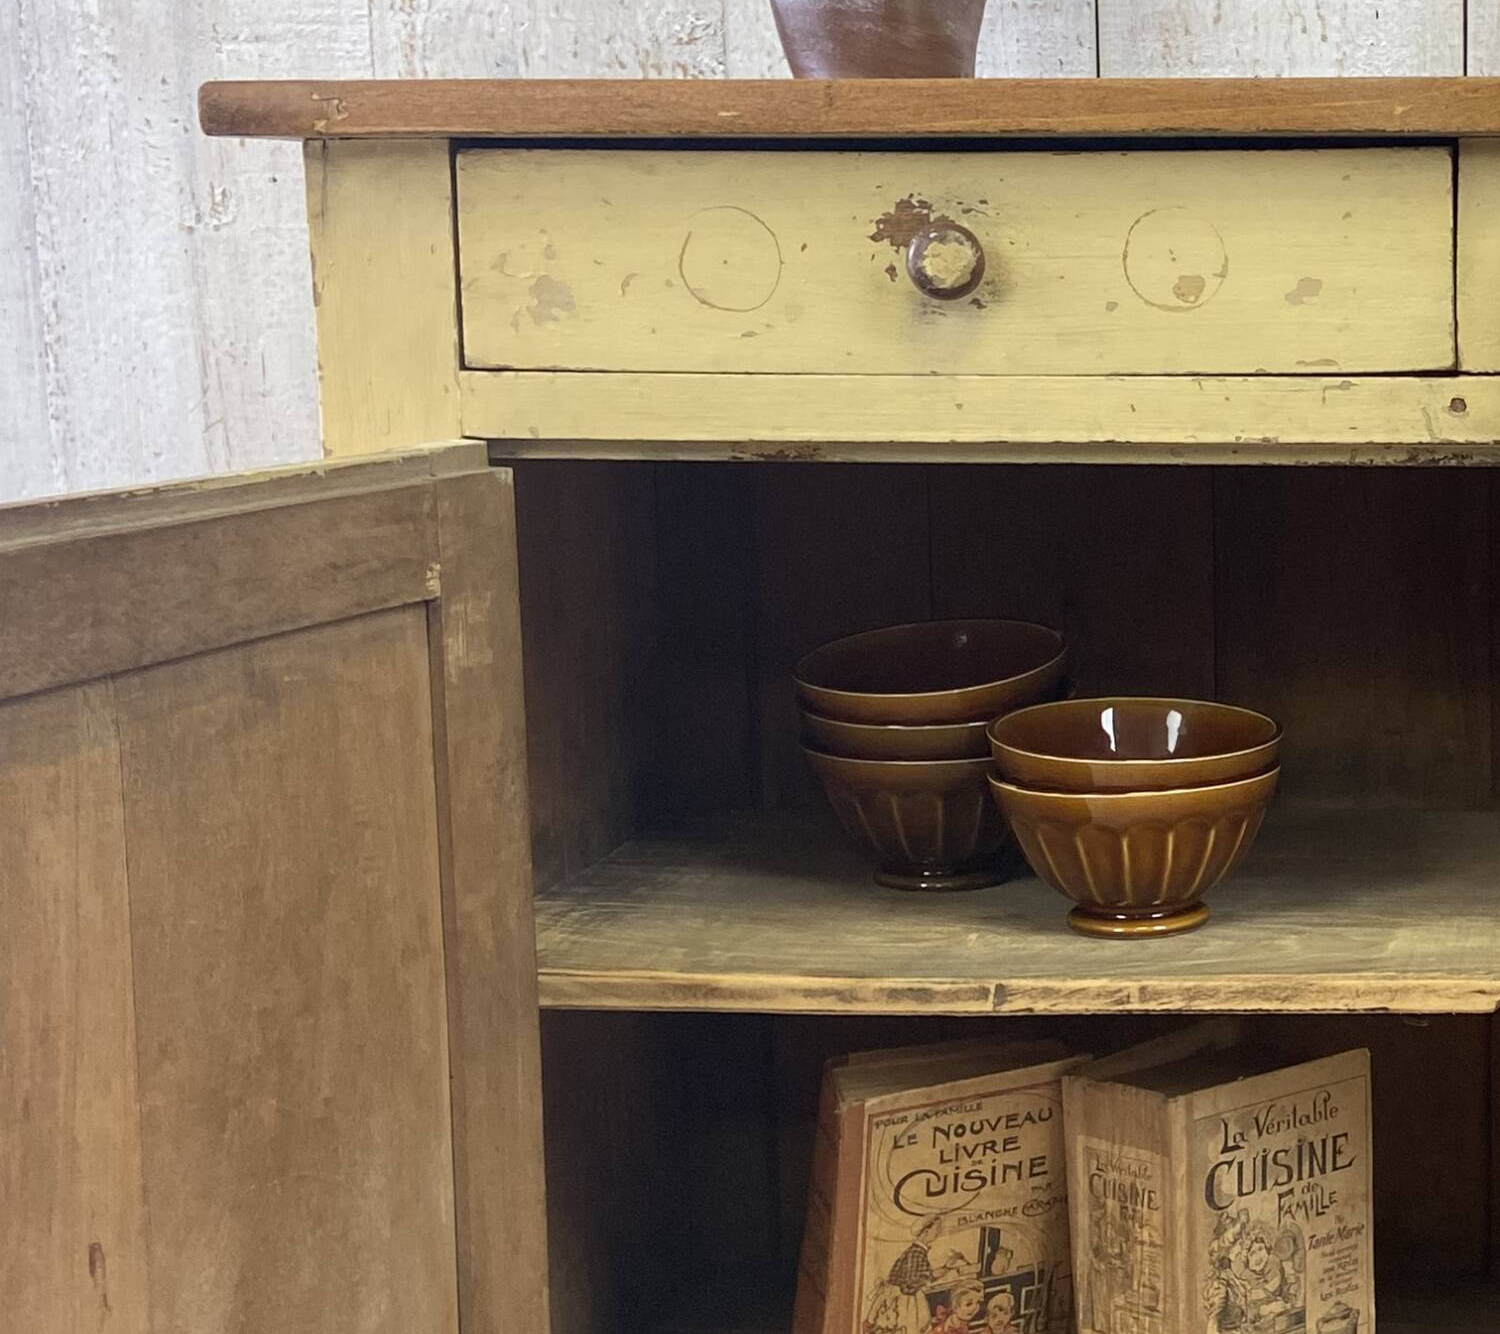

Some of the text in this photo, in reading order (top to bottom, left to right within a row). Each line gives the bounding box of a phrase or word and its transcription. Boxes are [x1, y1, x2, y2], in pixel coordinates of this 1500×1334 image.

[893, 1107, 1053, 1149] LE NOUVEAU
[1220, 1090, 1339, 1154] La Véritable
[939, 1135, 1021, 1165] LIVRE
[893, 1155, 1049, 1217] CUISINE
[1204, 1132, 1359, 1211] CUISINE
[957, 1205, 1018, 1228] BLANCHE
[1277, 1187, 1339, 1229] FAMILLE
